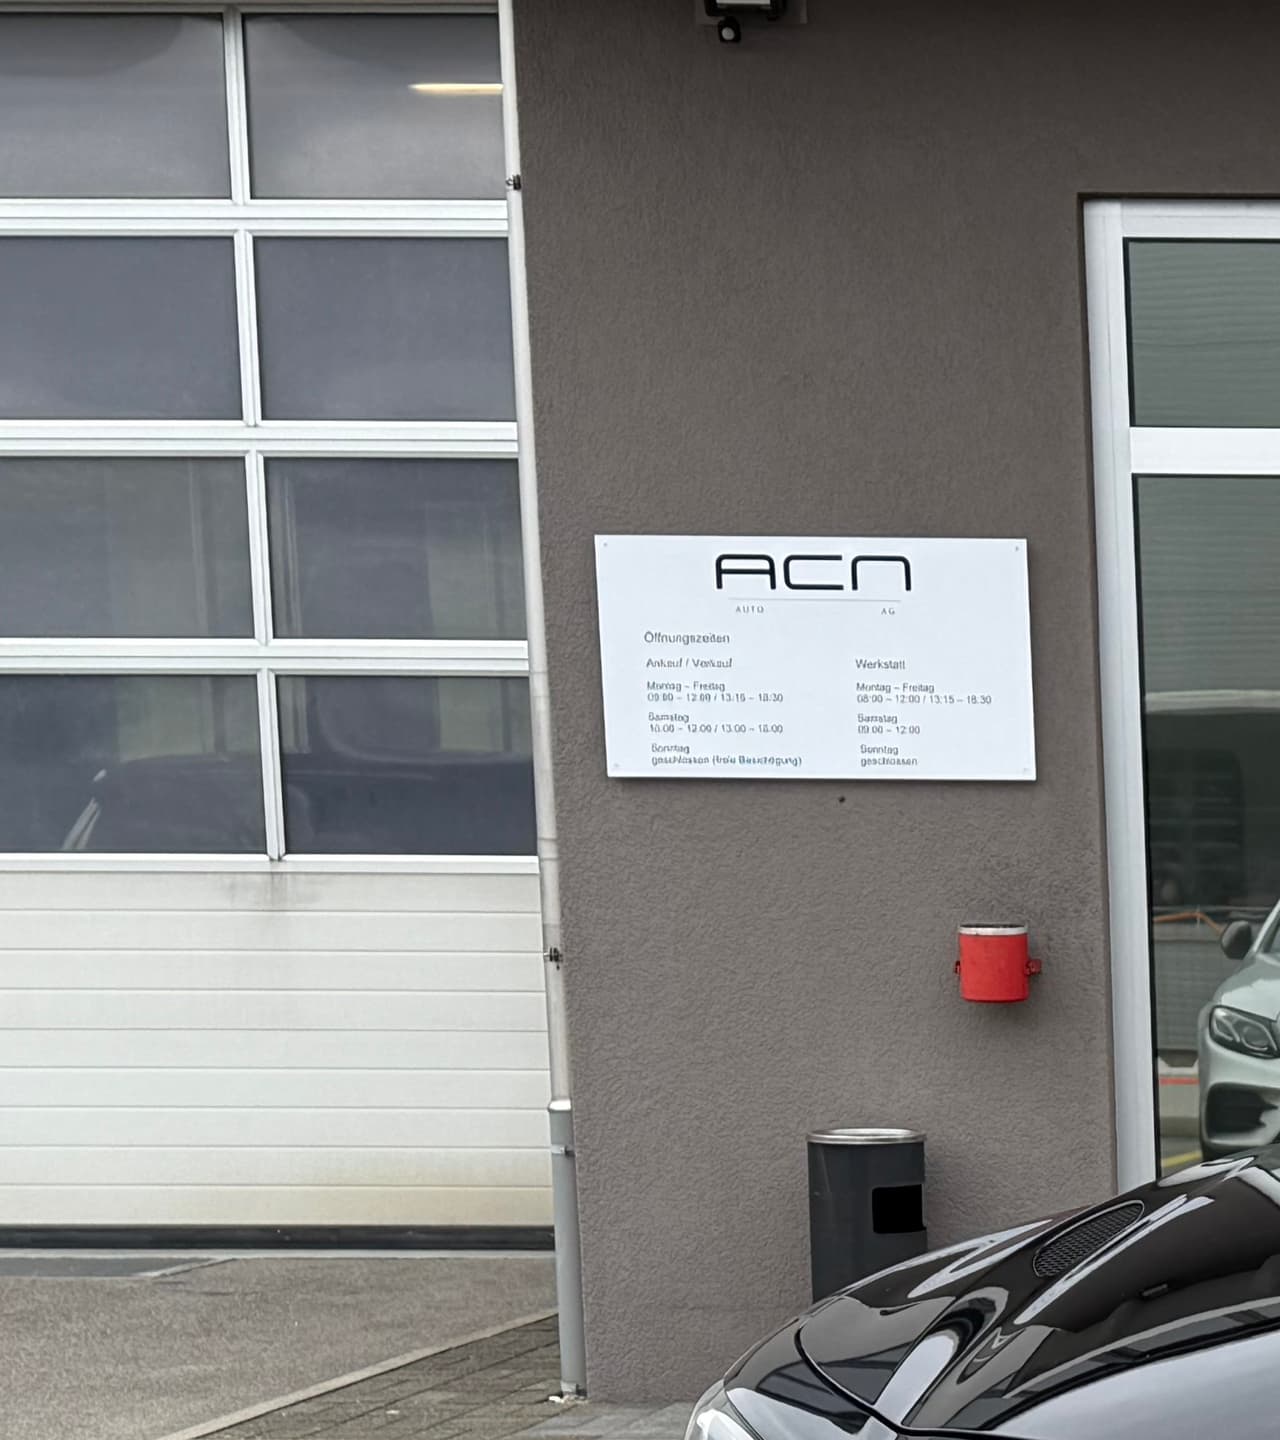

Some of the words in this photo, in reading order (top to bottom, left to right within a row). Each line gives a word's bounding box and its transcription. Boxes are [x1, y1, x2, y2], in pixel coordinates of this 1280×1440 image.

[644, 631, 729, 645] Öffnungszeiten
[646, 658, 682, 668] Ankauf
[692, 658, 732, 668] Verkauf
[856, 659, 905, 669] Werkstatt
[856, 683, 891, 693] Montag
[903, 683, 934, 693] Freitag
[860, 744, 898, 755] Sonntag
